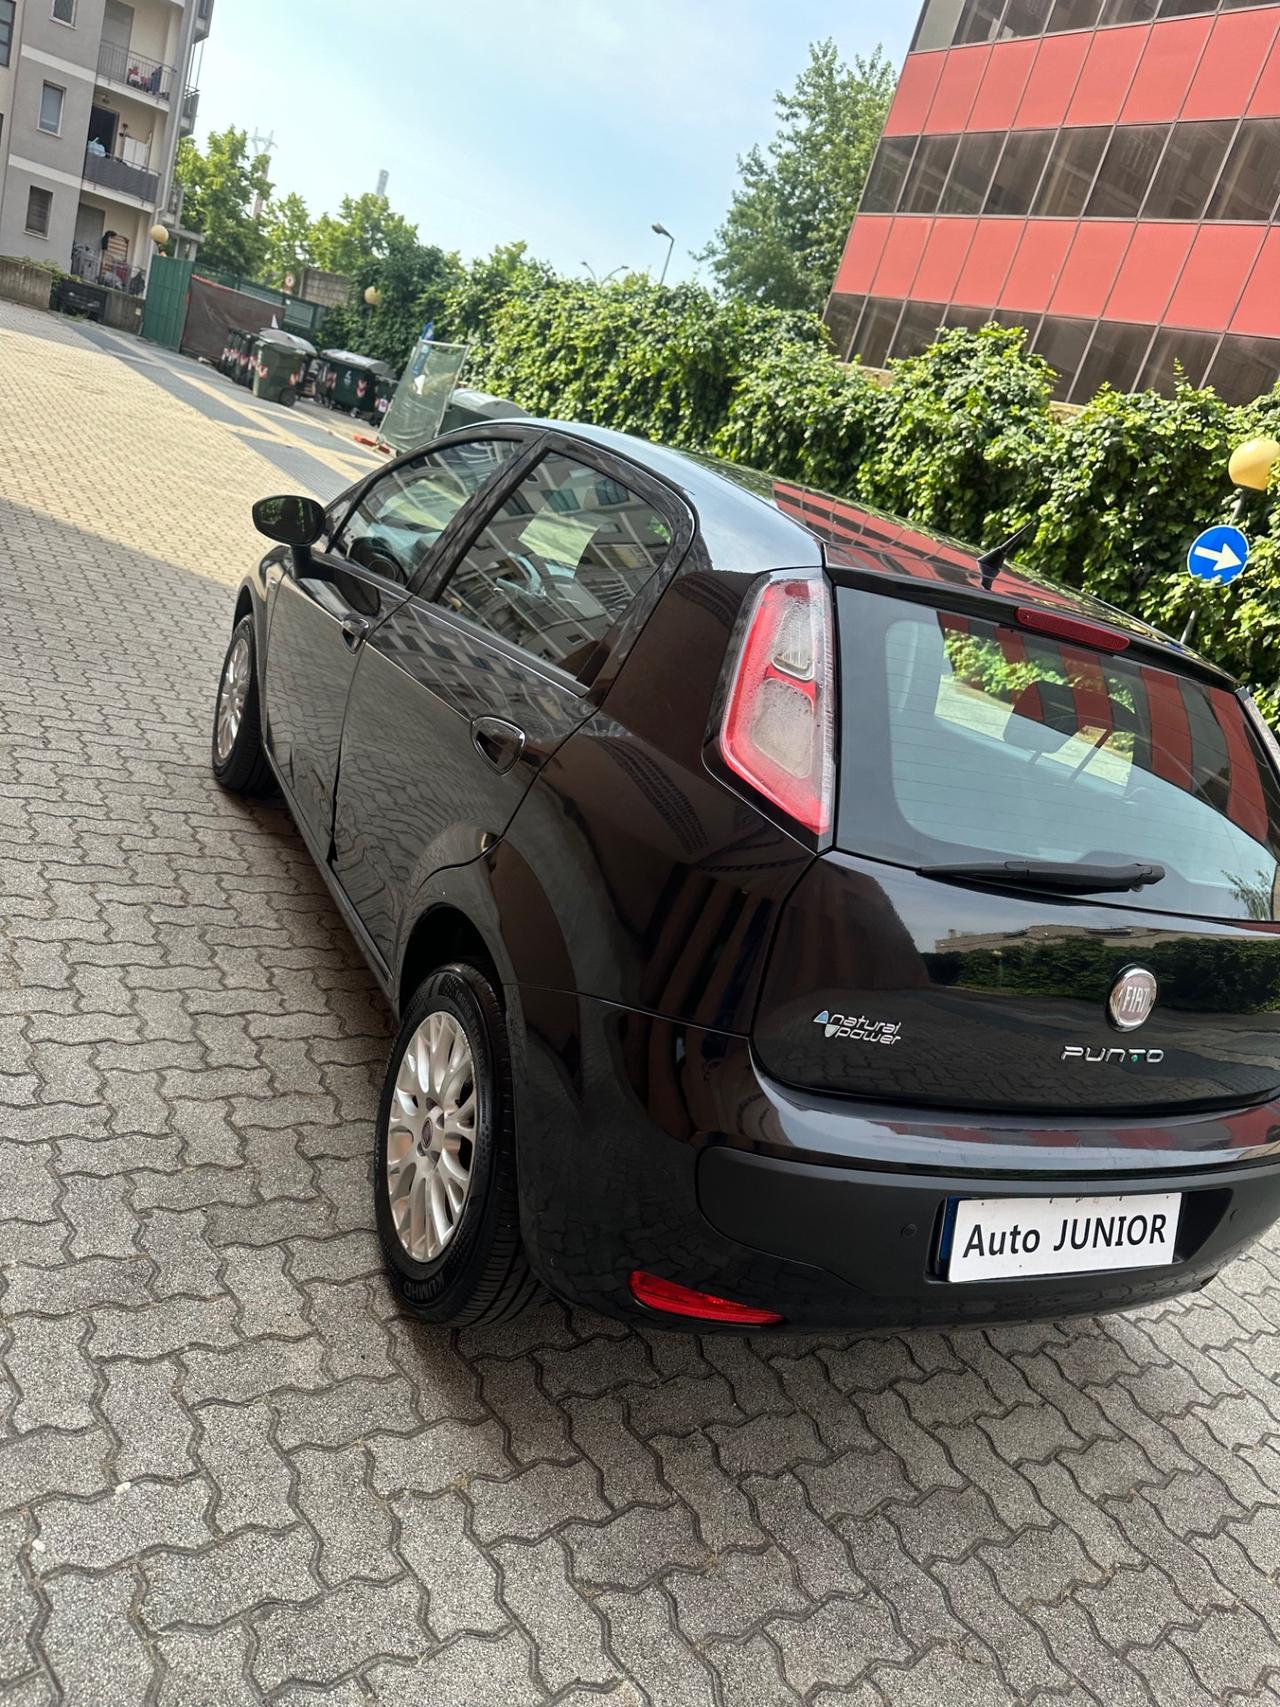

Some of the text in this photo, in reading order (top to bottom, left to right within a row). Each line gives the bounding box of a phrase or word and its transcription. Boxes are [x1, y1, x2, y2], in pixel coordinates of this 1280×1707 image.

[1121, 985, 1151, 1012] FIAT
[829, 1014, 902, 1035] natural
[834, 1027, 902, 1045] power
[1060, 1045, 1164, 1063] PUNTO
[962, 1214, 1167, 1258] Auto JUNIOR
[403, 1271, 445, 1300] KUMHO
